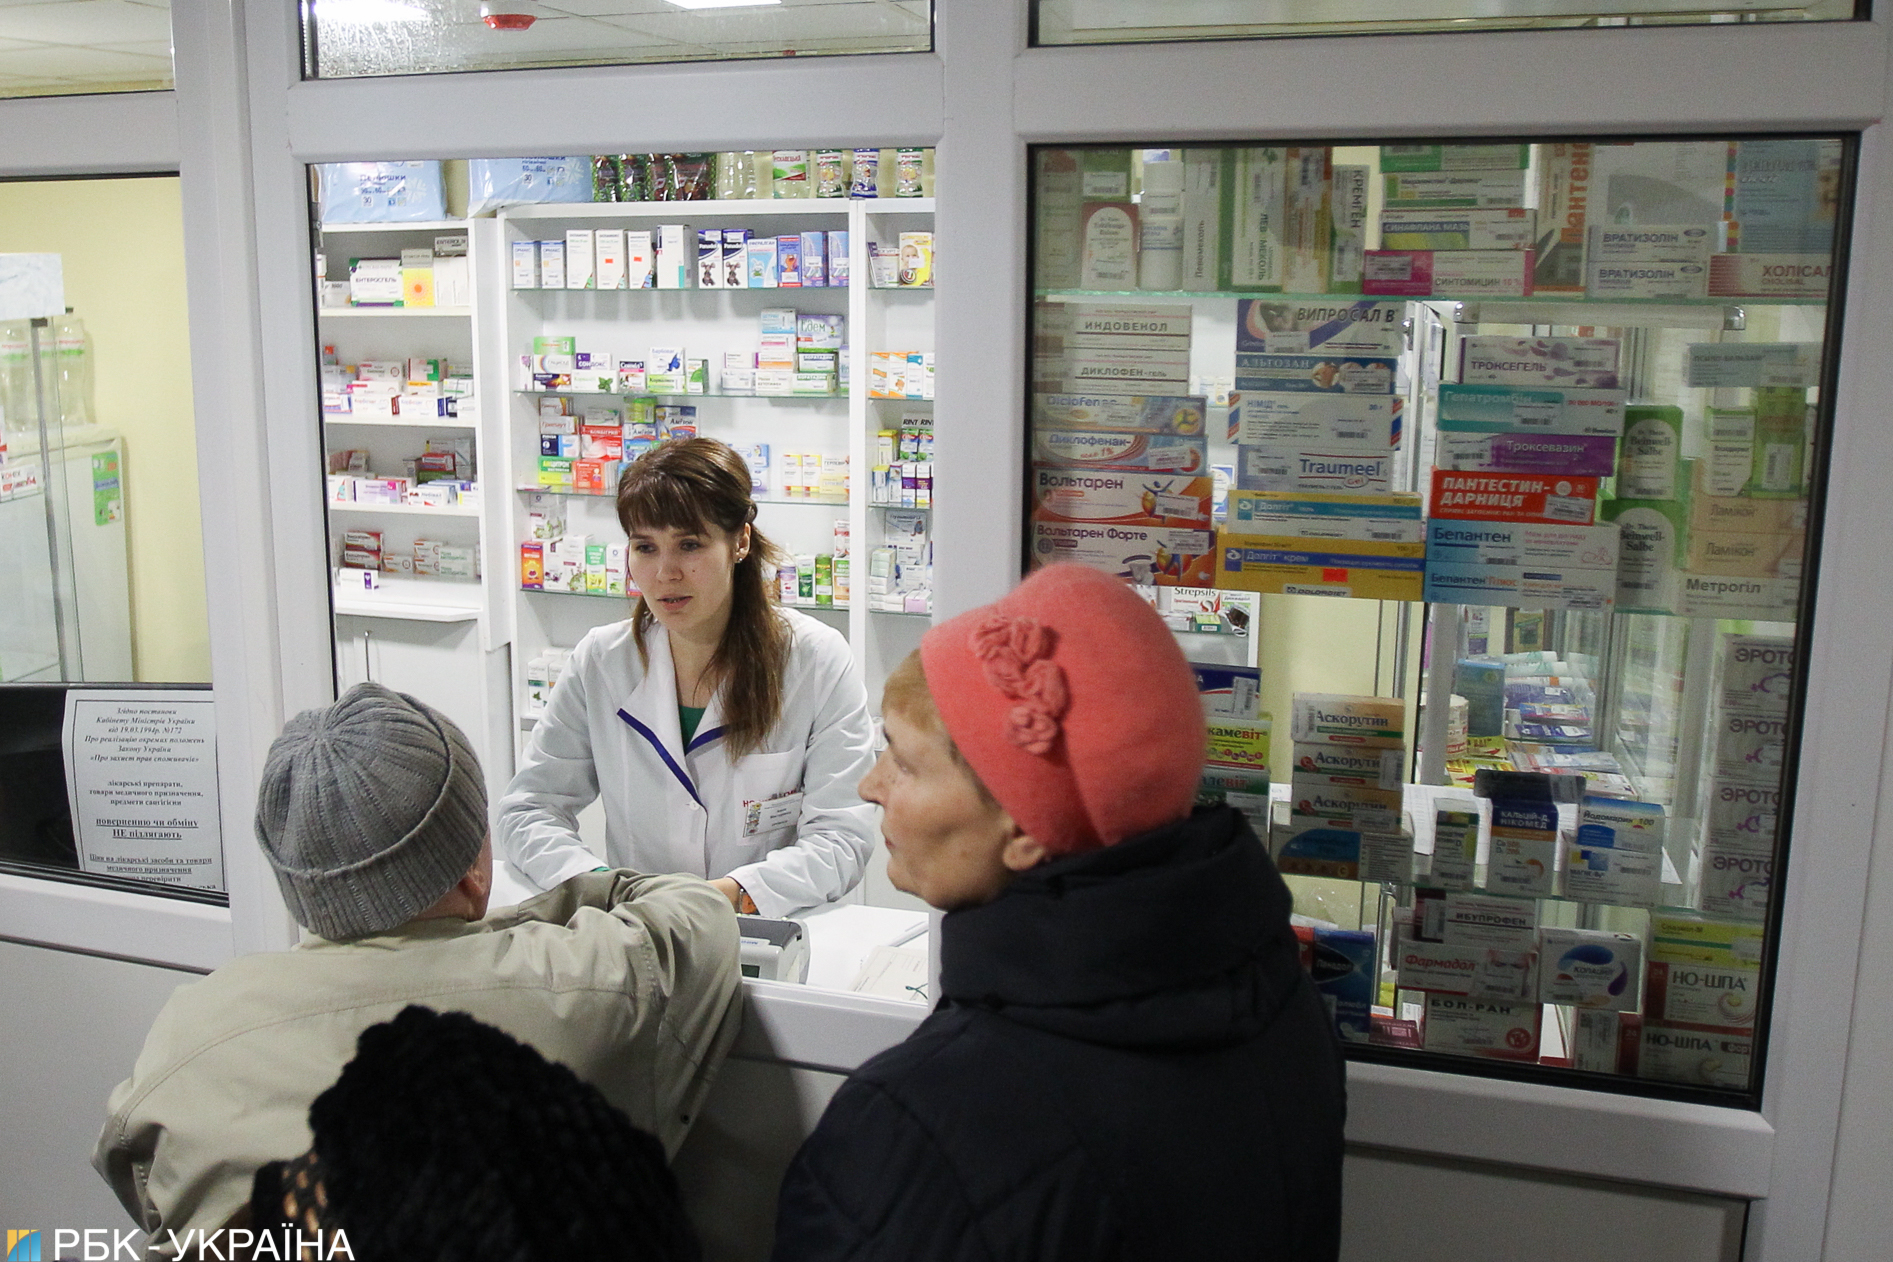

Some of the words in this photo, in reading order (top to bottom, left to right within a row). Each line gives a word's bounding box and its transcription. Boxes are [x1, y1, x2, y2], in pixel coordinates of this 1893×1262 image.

[1350, 169, 1362, 228] КРЕМГЕН
[1603, 232, 1678, 243] ВРАТИЗОЛІН
[1599, 268, 1674, 279] ВРАТИЗОЛІН
[1436, 276, 1500, 287] СИНТОМИЦИН
[1297, 308, 1380, 322] ВИПРОСАЛ
[1085, 321, 1168, 332] ИНДОВЕНОЛ
[1242, 358, 1310, 368] АЛЬГОЗАН
[1472, 361, 1547, 372] ТРОКСЕГЕЛЬ
[1445, 392, 1533, 404] Гепатромбін
[1050, 434, 1132, 446] Диклофенак-
[1507, 440, 1586, 453] Троксевазин
[1300, 458, 1380, 476] Traumeel
[1039, 472, 1124, 490] Вольтарен
[1443, 478, 1551, 493] ПАНТЕСТИН-
[1440, 492, 1524, 508] ДАРНИЦЯ
[1037, 524, 1104, 539] Вольтарен
[1107, 528, 1148, 541] Форте
[1434, 527, 1512, 542] Бепантен
[1625, 541, 1655, 552] Salbe
[1431, 572, 1486, 585] Бепантен
[1686, 578, 1762, 593] Метрогіл
[1174, 587, 1216, 597] Strepsils
[1316, 710, 1388, 727] Аскорутин
[84, 736, 98, 744] Про
[1206, 726, 1262, 741] камевіт
[1316, 751, 1380, 768] Аскорути
[1314, 796, 1388, 811] Аскорутин
[1500, 818, 1548, 830] НІКОМЕД
[1638, 816, 1655, 826] 100
[113, 829, 127, 838] НЕ
[1456, 912, 1526, 926] ИБУПРОФЕН
[1405, 954, 1476, 971] Фармадол
[1672, 971, 1746, 991] НО-ШПА
[1432, 1000, 1511, 1014] БОЛ-РАН
[1646, 1034, 1712, 1050] НО-ШПА
